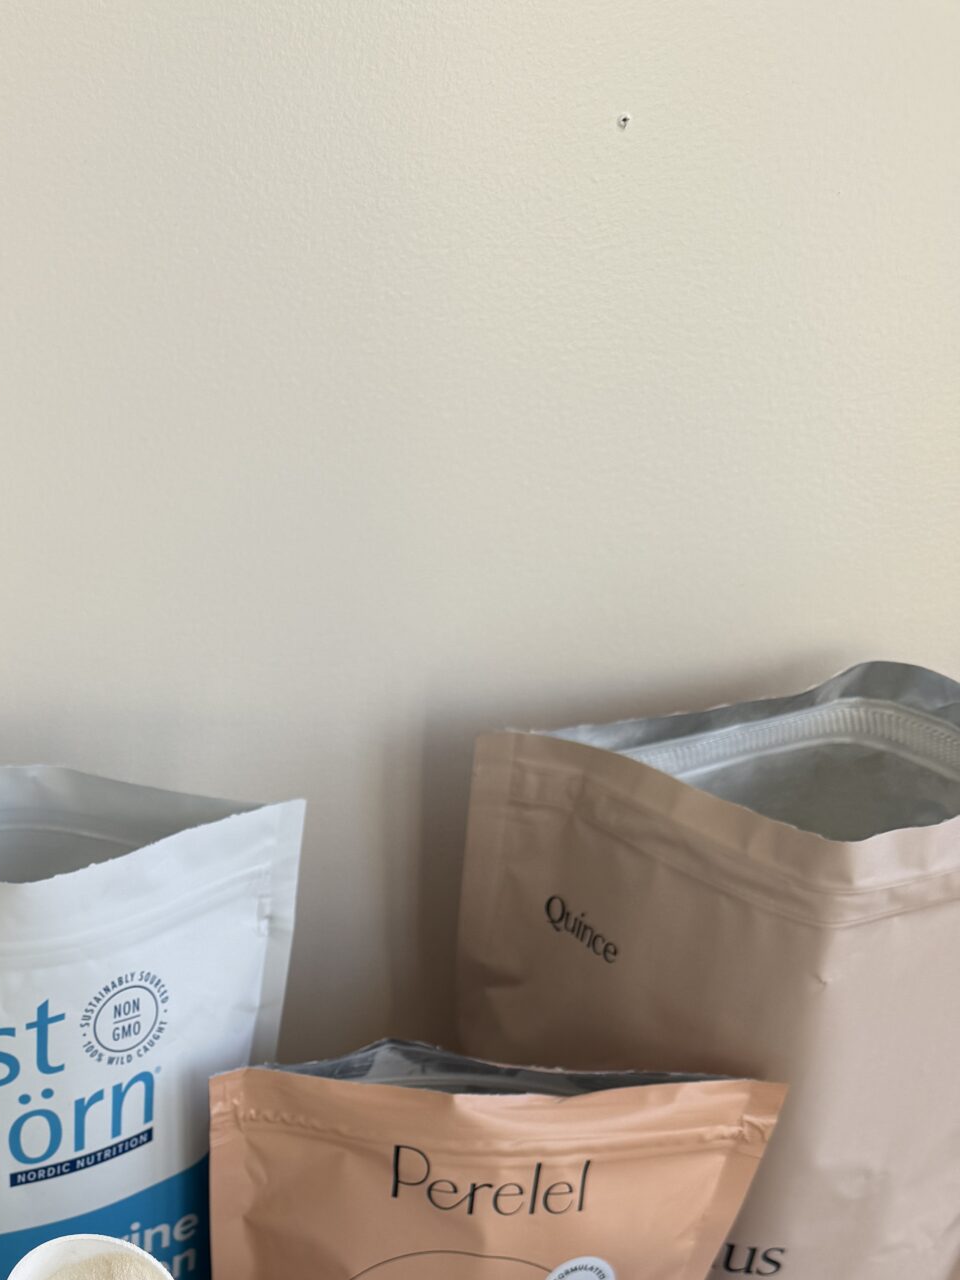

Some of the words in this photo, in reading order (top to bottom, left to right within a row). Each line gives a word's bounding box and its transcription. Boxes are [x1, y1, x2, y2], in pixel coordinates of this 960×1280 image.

[544, 894, 619, 964] Quince
[80, 972, 136, 1028] SUSTAINABLY
[138, 970, 169, 1004] SOURCED
[113, 997, 140, 1019] NON
[106, 1054, 133, 1065] WILD
[136, 1020, 168, 1058] CAUGHT
[112, 1020, 141, 1042] GMO
[16, 1162, 70, 1184] NORDIC
[75, 1131, 149, 1169] NUTRITION
[391, 1144, 591, 1217] Perelel
